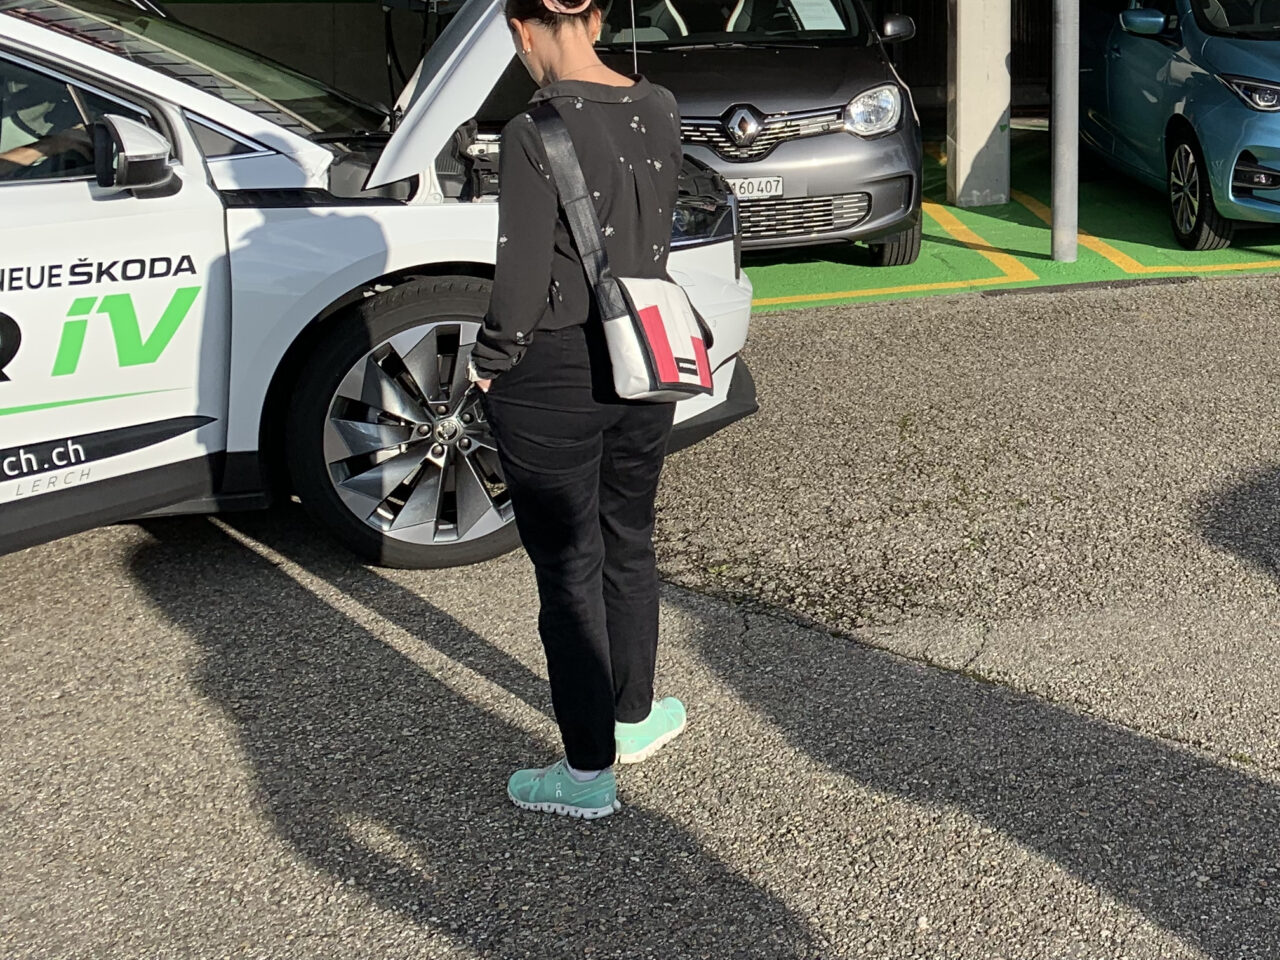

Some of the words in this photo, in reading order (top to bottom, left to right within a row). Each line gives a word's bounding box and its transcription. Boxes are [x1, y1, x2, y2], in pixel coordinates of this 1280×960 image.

[68, 254, 197, 286] ŠKODA
[50, 285, 203, 377] iV
[15, 467, 92, 497] LERCH
